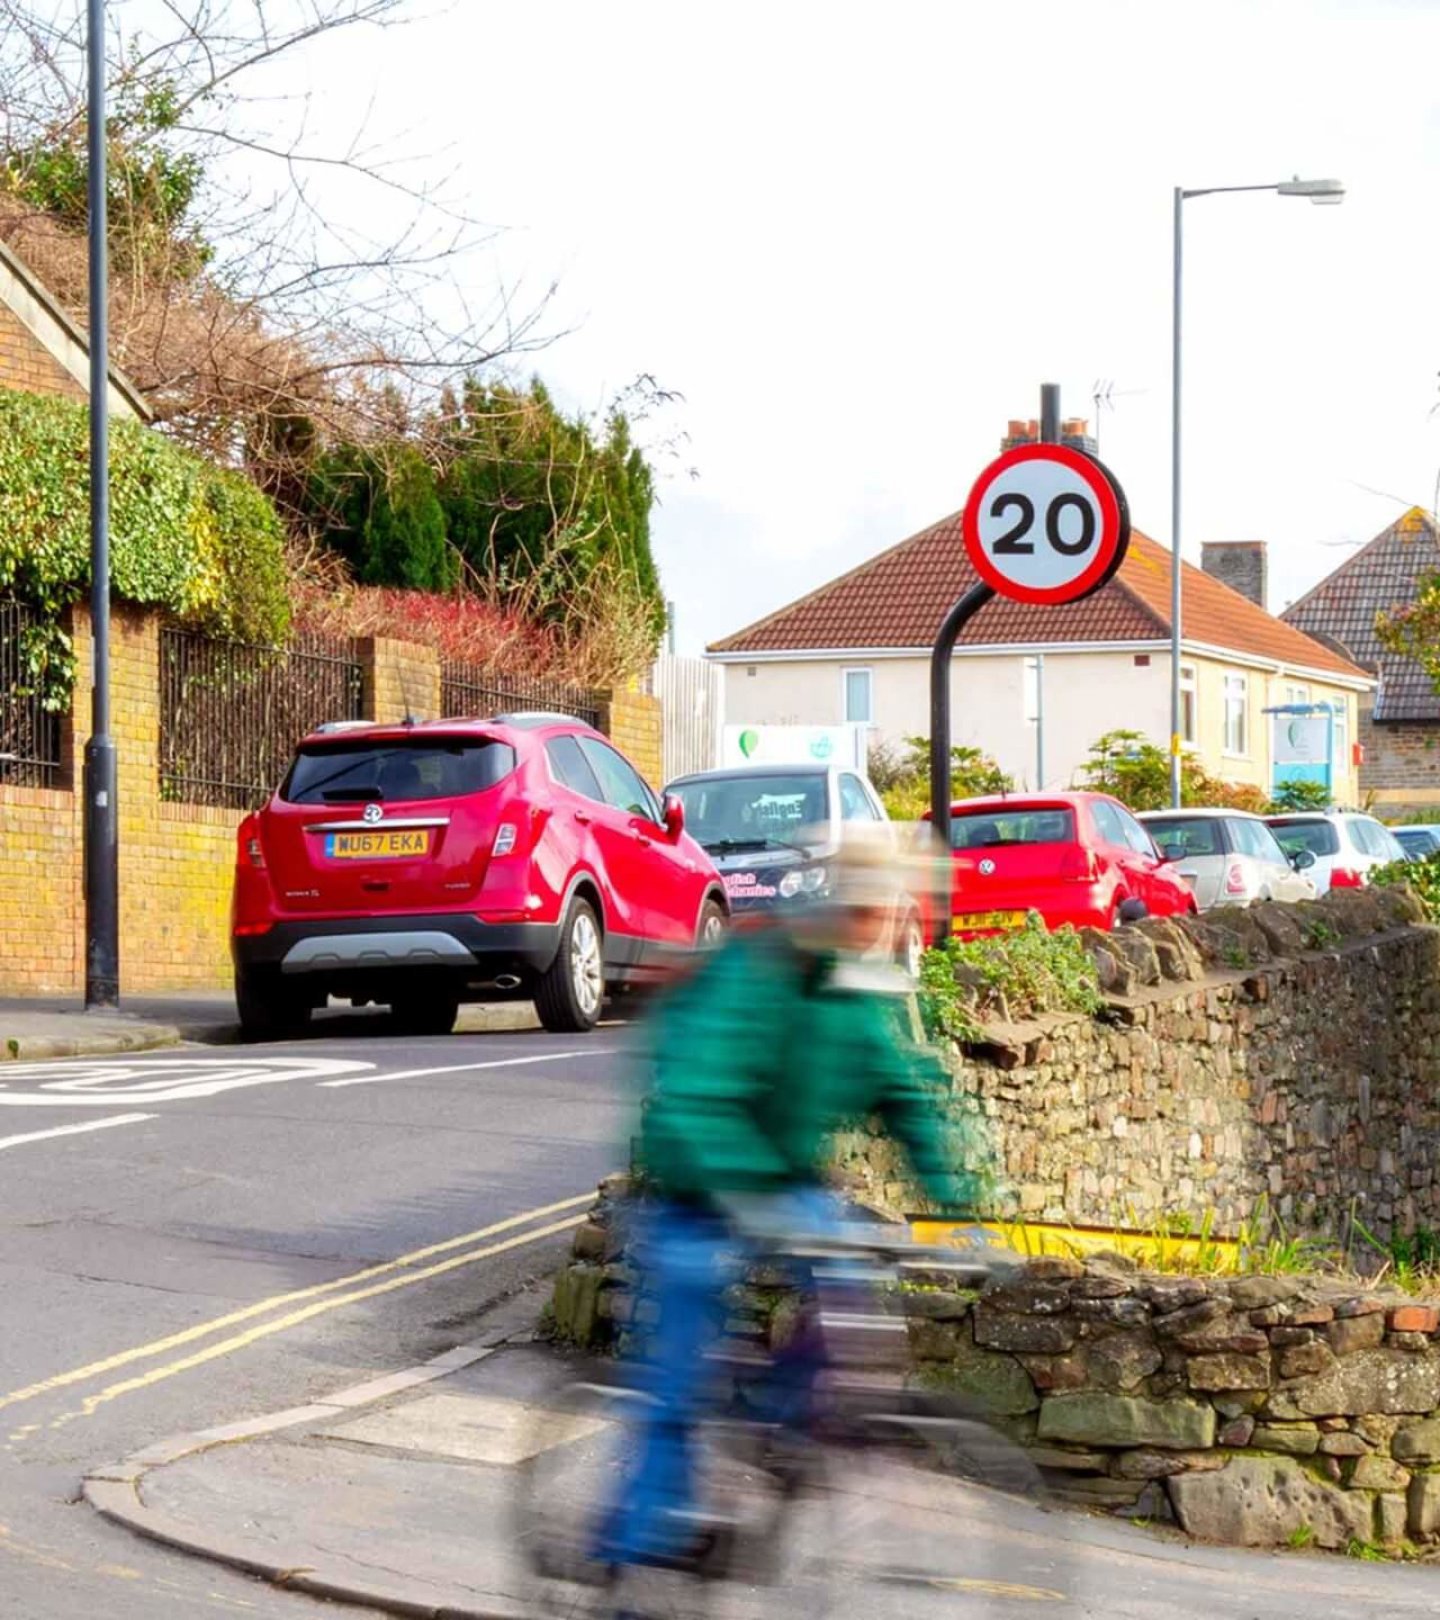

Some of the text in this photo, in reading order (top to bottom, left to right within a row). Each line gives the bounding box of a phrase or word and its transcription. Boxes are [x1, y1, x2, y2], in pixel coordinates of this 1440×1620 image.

[990, 492, 1095, 556] 20
[339, 834, 424, 853] WU67 EKA
